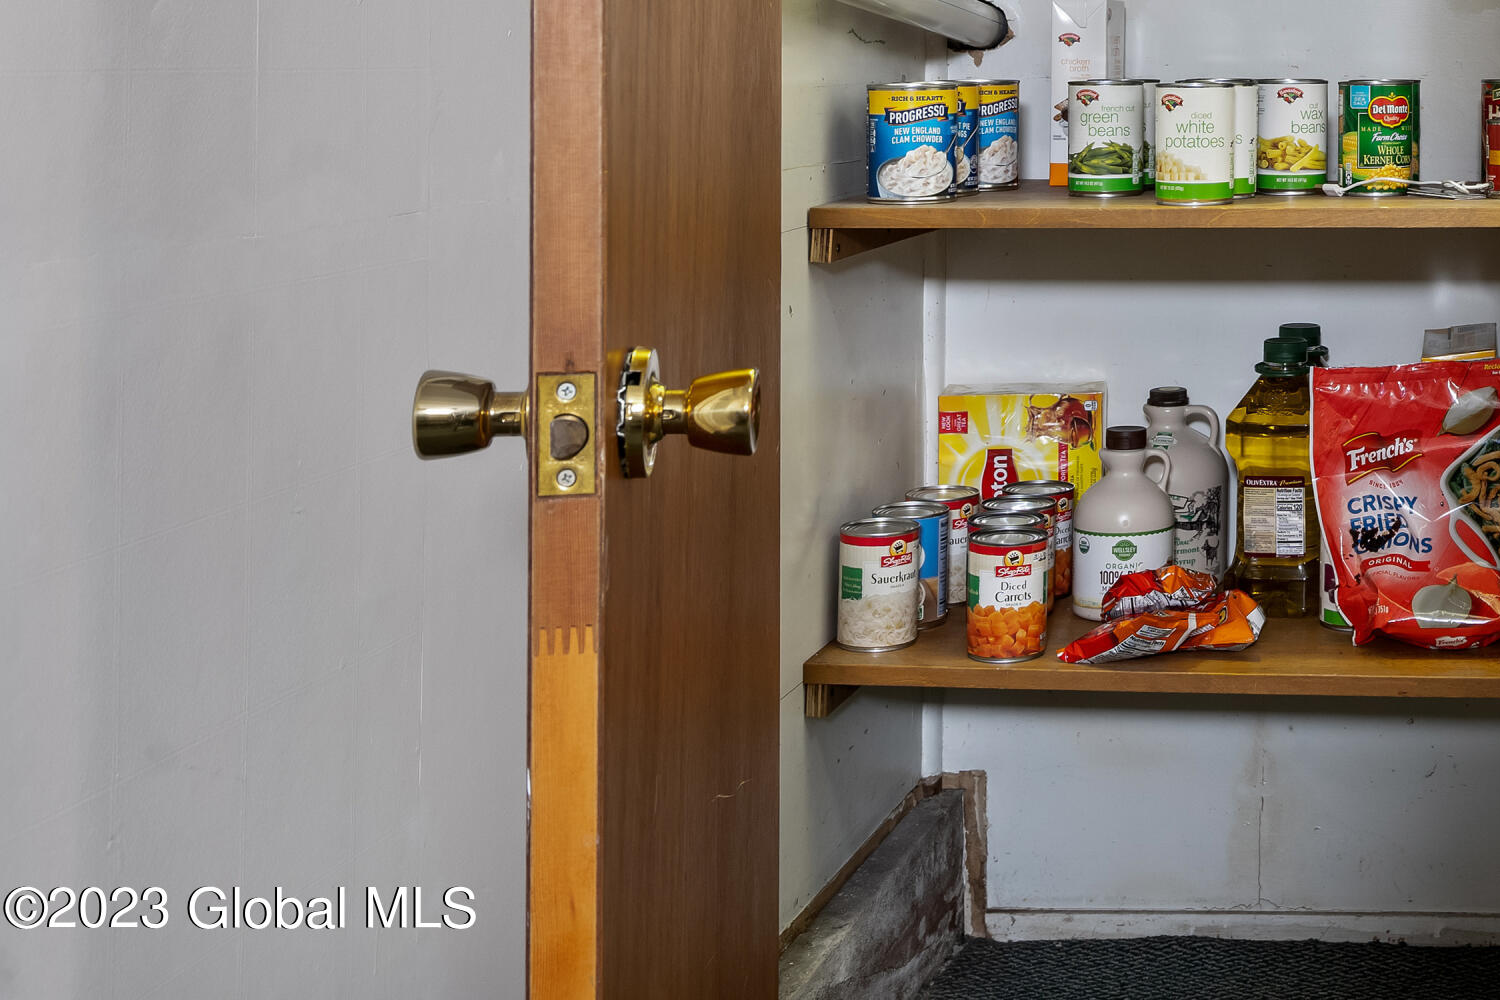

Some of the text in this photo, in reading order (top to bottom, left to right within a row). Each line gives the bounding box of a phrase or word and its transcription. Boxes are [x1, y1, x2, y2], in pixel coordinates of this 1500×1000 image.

[1060, 58, 1090, 66] chicken
[1070, 64, 1089, 72] broth
[889, 104, 946, 124] PROGRESSO
[1300, 108, 1324, 120] wax
[1372, 104, 1408, 114] Del Monte
[1080, 112, 1118, 126] green
[1190, 112, 1212, 120] diced
[894, 126, 941, 136] NEW ENGLAND
[1088, 126, 1130, 137] beans
[1176, 120, 1215, 134] white
[1291, 121, 1326, 134] beans
[891, 135, 943, 144] CLAM CHOWDER
[1165, 135, 1225, 150] potatoes
[1378, 145, 1404, 155] WHOLE
[1364, 154, 1394, 164] KERNEL
[1346, 437, 1415, 472] French's
[1347, 494, 1418, 515] CRISPY
[1350, 513, 1409, 532] FRIED
[1368, 557, 1413, 569] ORIGINAL
[870, 570, 918, 585] Sauerkraut
[1000, 580, 1027, 591] Diced
[995, 592, 1032, 603] Carrots
